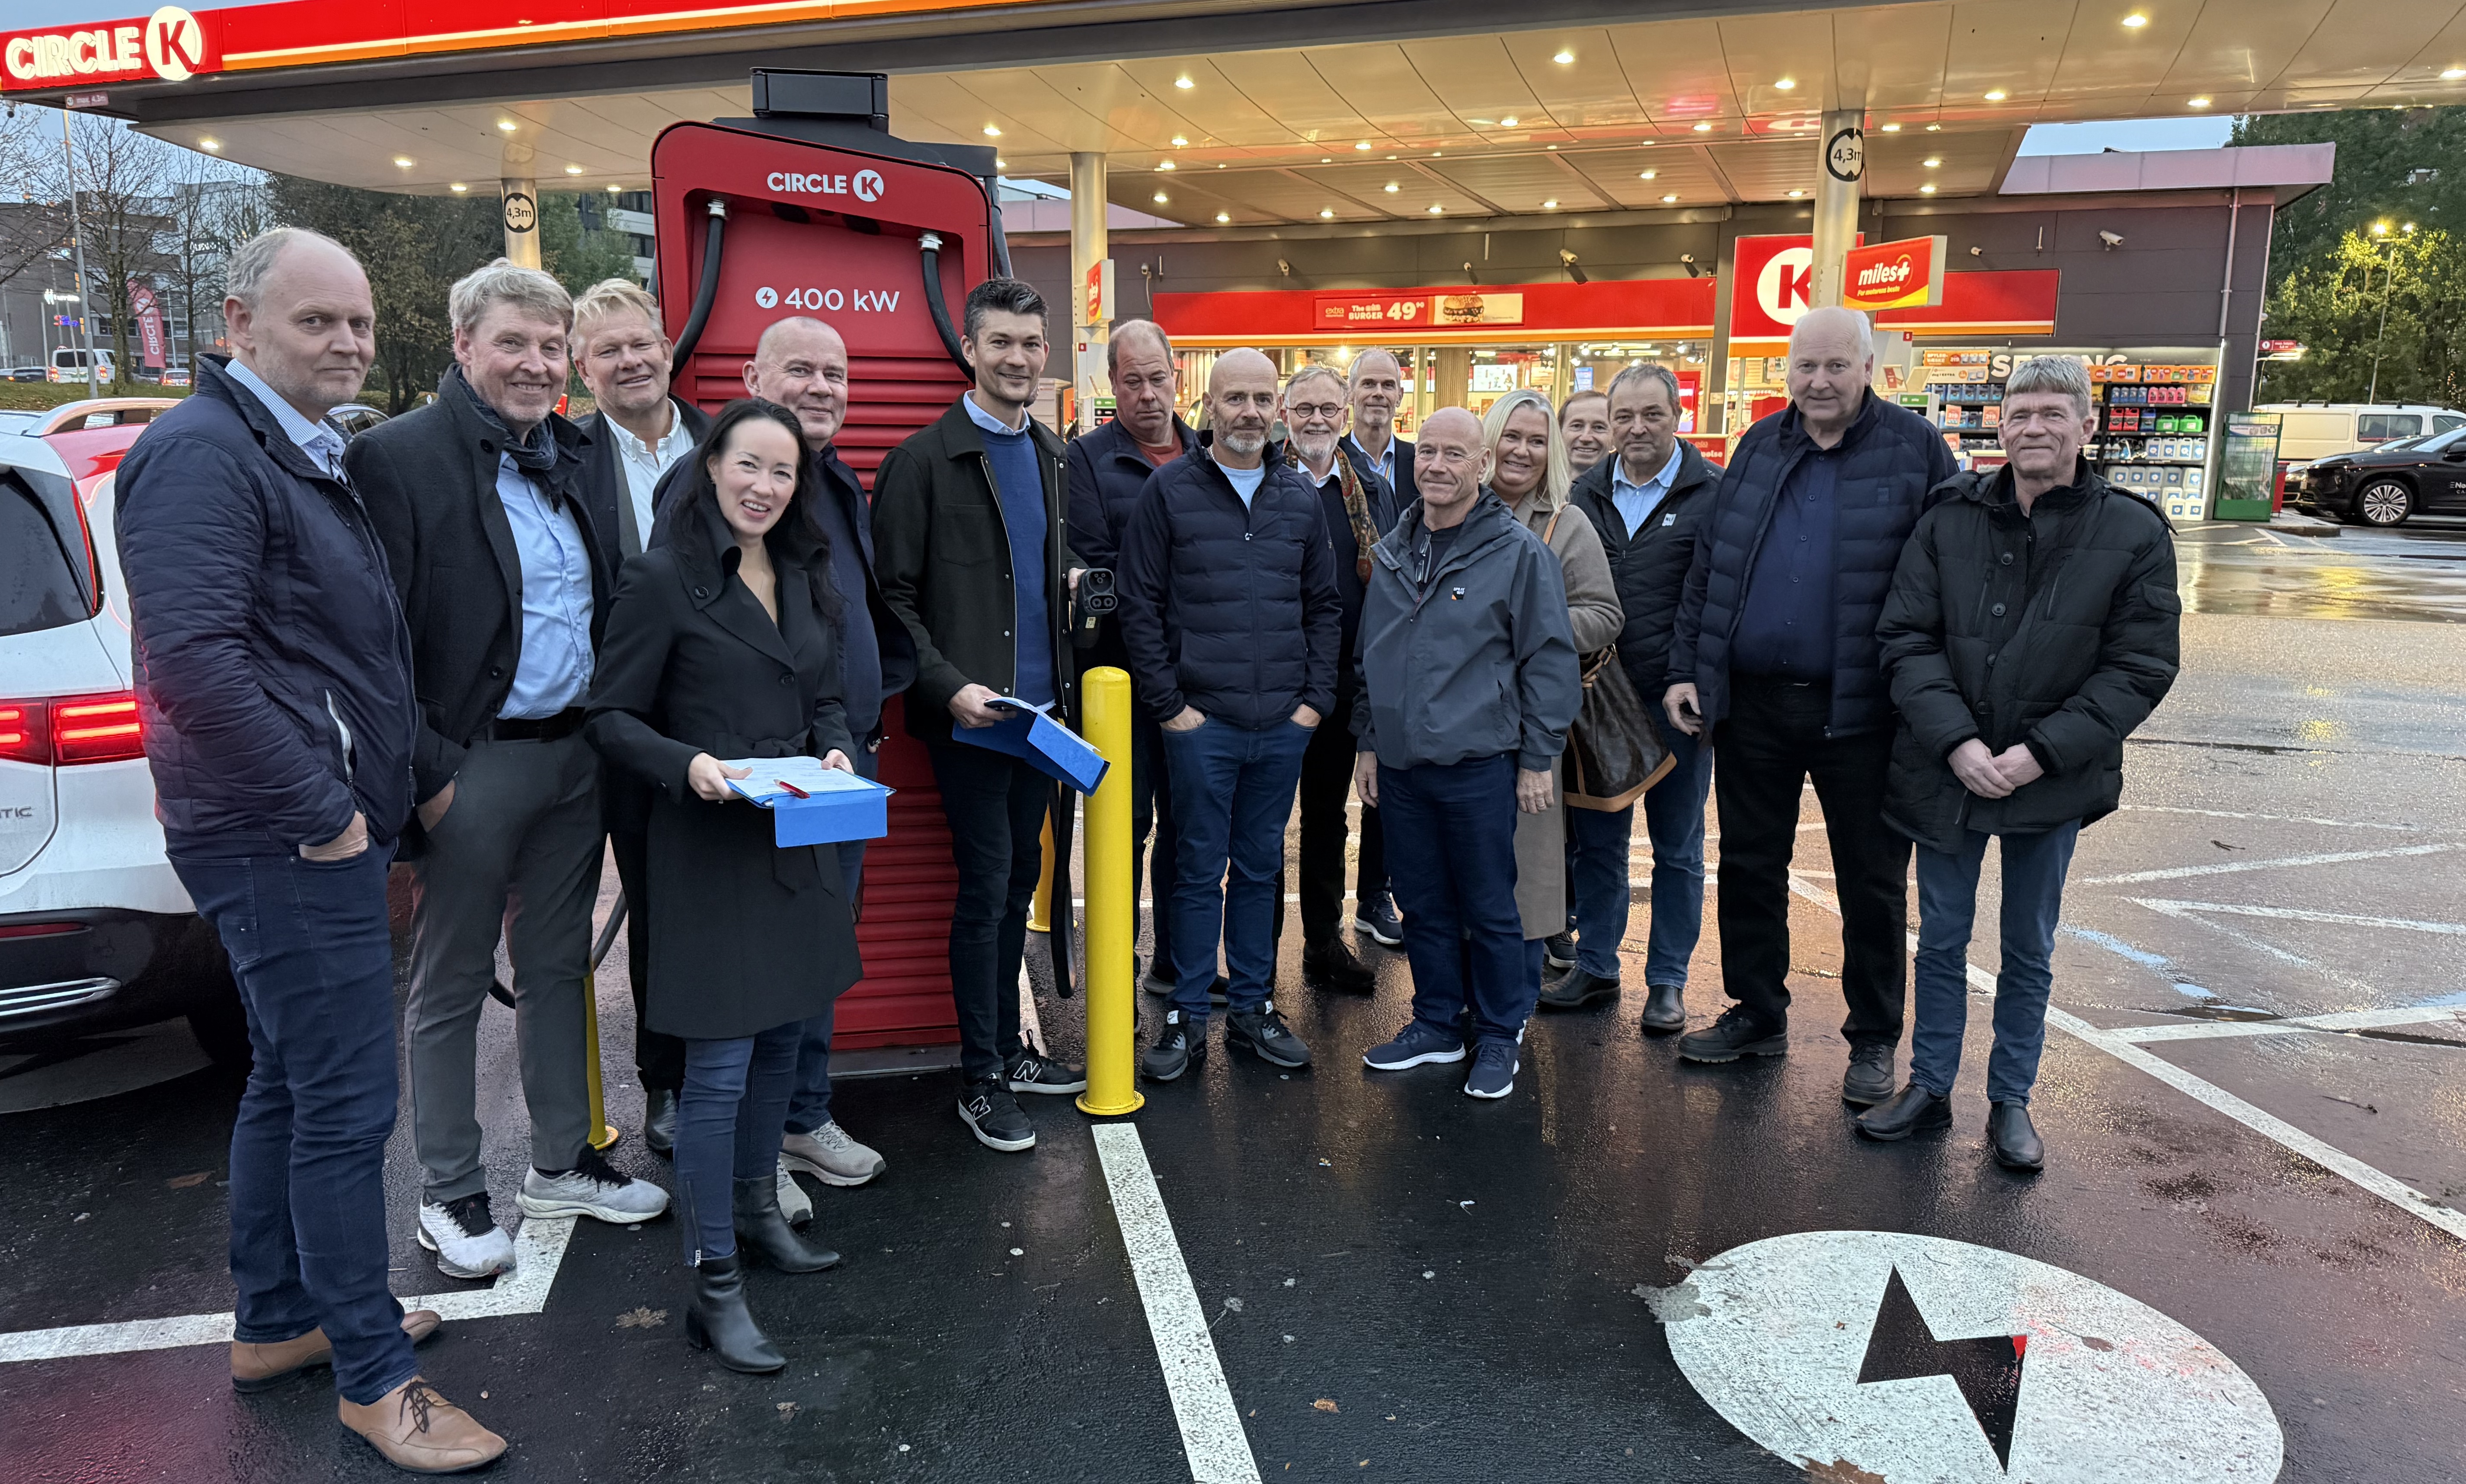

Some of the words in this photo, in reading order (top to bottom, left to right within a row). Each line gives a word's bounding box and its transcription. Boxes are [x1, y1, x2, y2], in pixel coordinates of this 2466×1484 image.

[6, 26, 141, 80] CIRCLE
[157, 18, 200, 75] K
[767, 172, 847, 194] CIRCLE
[860, 175, 883, 201] K
[507, 207, 531, 219] 4,3m
[784, 288, 844, 310] 400
[854, 289, 900, 312] kW
[1325, 306, 1344, 314] extra
[1348, 312, 1383, 320] BURGER
[1386, 302, 1416, 320] 49
[0, 806, 32, 818] TIC
